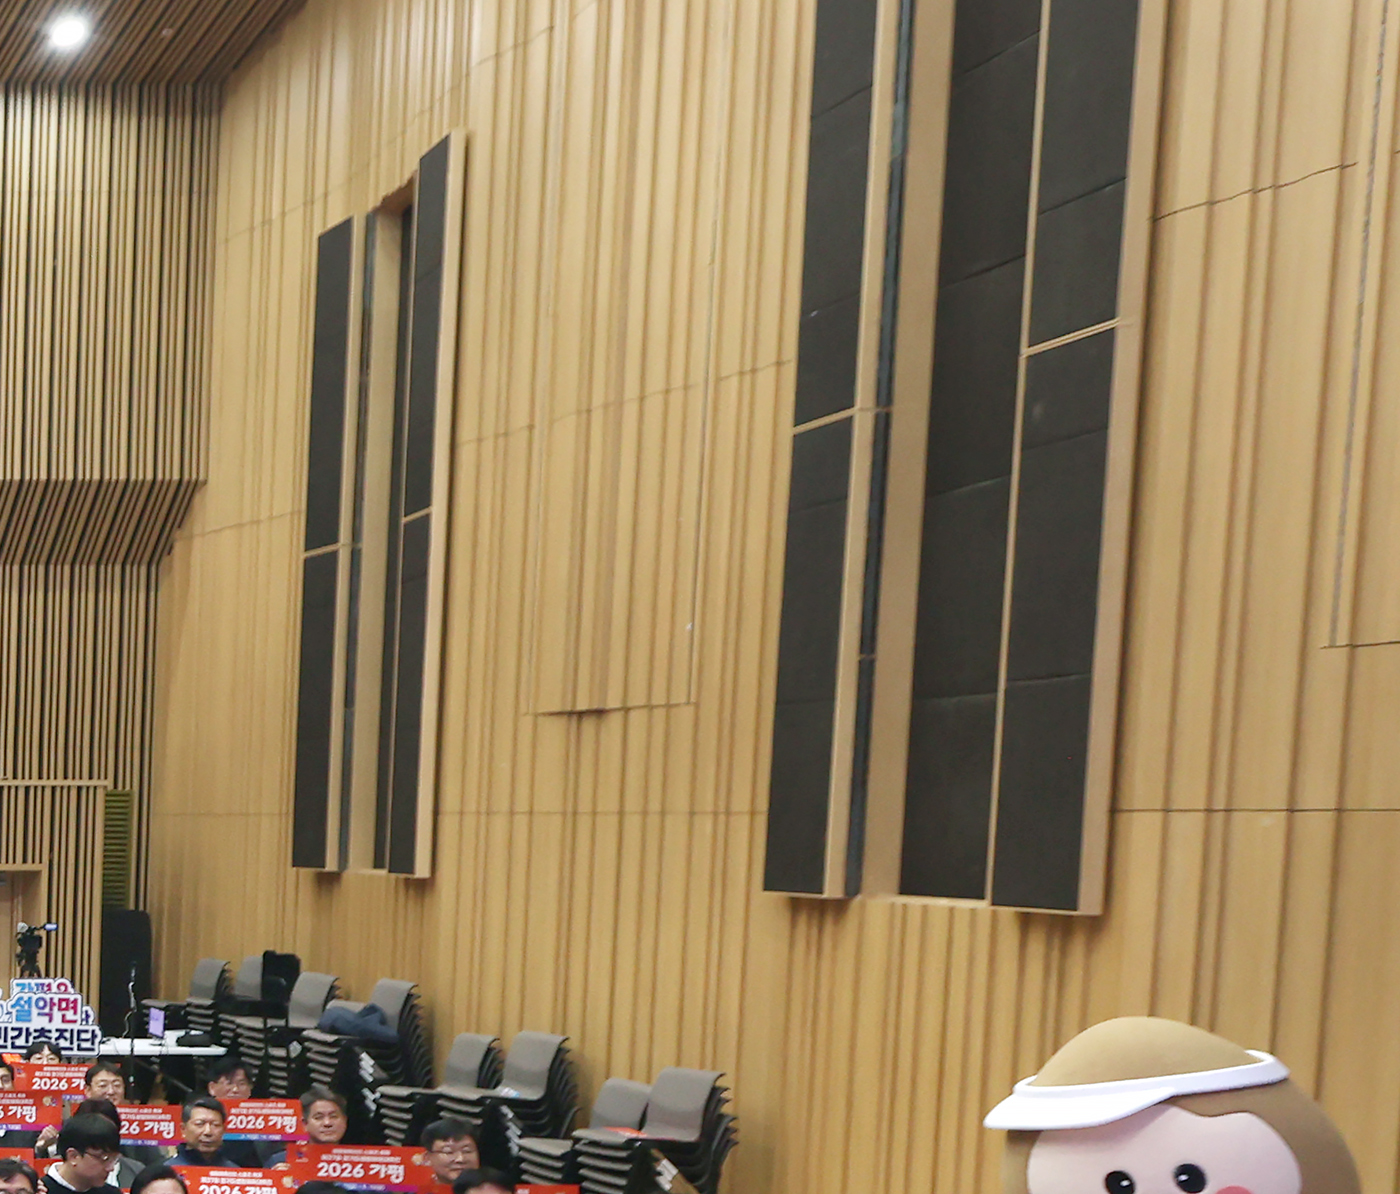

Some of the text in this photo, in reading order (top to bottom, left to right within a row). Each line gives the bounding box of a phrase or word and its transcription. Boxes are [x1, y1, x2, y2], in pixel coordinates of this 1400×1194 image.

[11, 996, 79, 1023] 설악면
[227, 1114, 297, 1133] 2026 가평
[317, 1162, 405, 1182] 2026 가평
